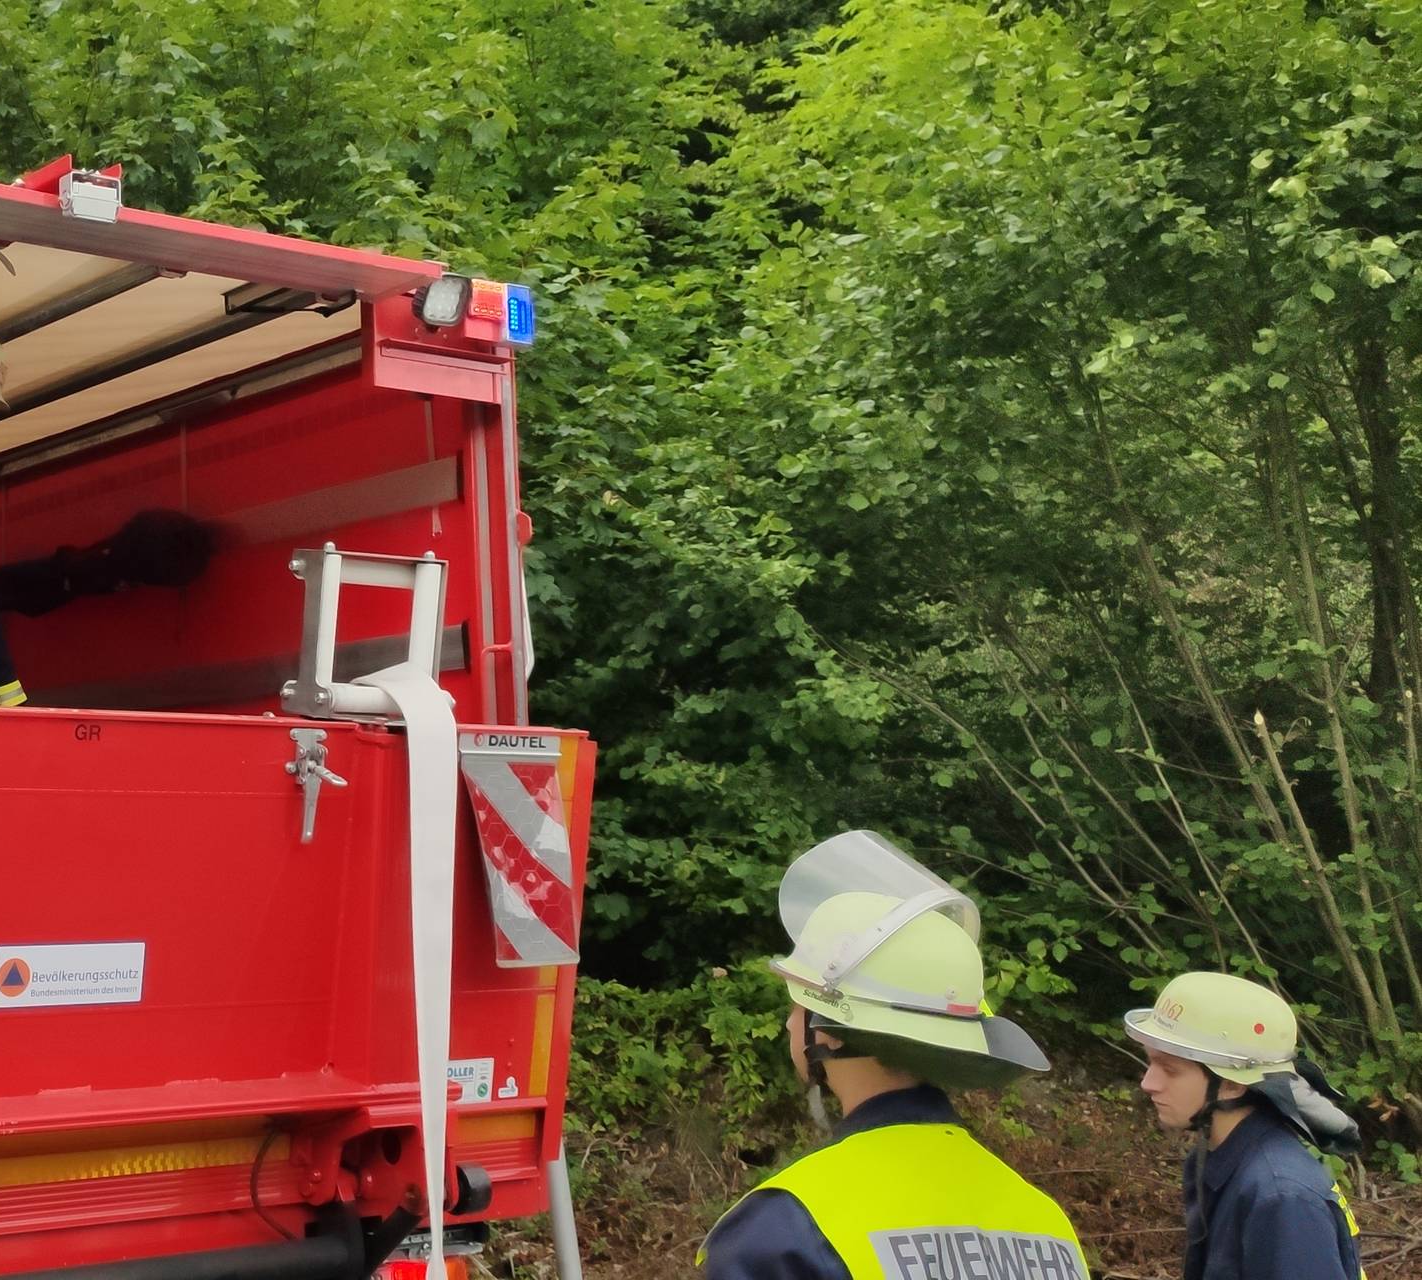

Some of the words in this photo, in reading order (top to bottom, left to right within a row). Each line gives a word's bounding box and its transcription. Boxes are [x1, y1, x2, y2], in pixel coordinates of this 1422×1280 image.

[75, 724, 101, 741] GR
[488, 735, 546, 748] DAUTEL
[32, 969, 139, 983] Bevölkerungsschutz
[30, 988, 99, 998] Bundesministerium
